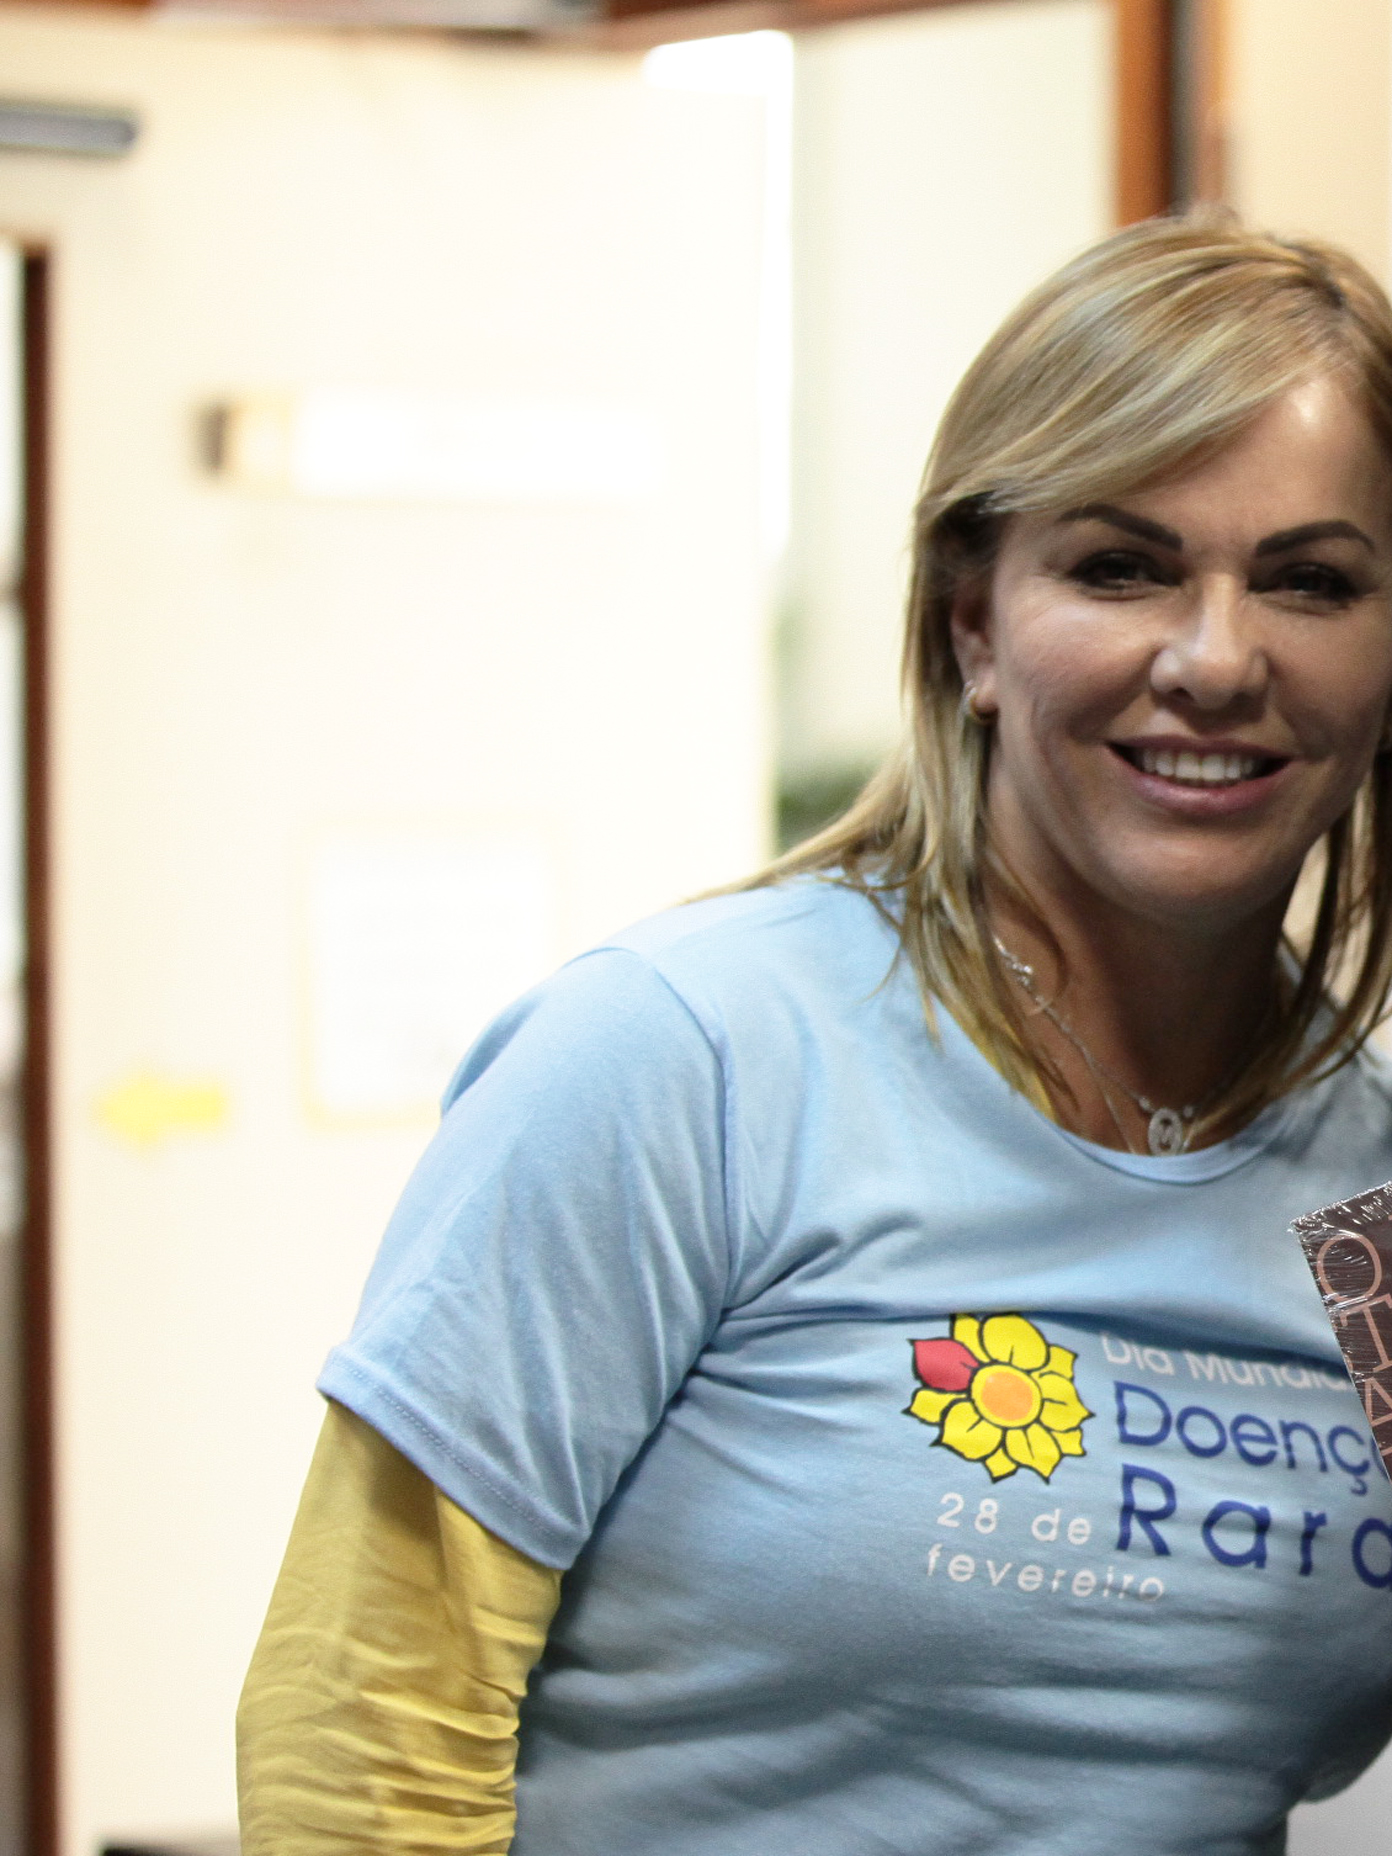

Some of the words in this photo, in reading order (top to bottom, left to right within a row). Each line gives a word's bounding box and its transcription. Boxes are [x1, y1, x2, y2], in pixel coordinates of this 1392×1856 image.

[1315, 1233, 1383, 1301] O
[1114, 1380, 1388, 1496] Doenç
[936, 1492, 999, 1535] 28
[1030, 1507, 1093, 1545] de
[926, 1544, 1166, 1602] fevereiro
